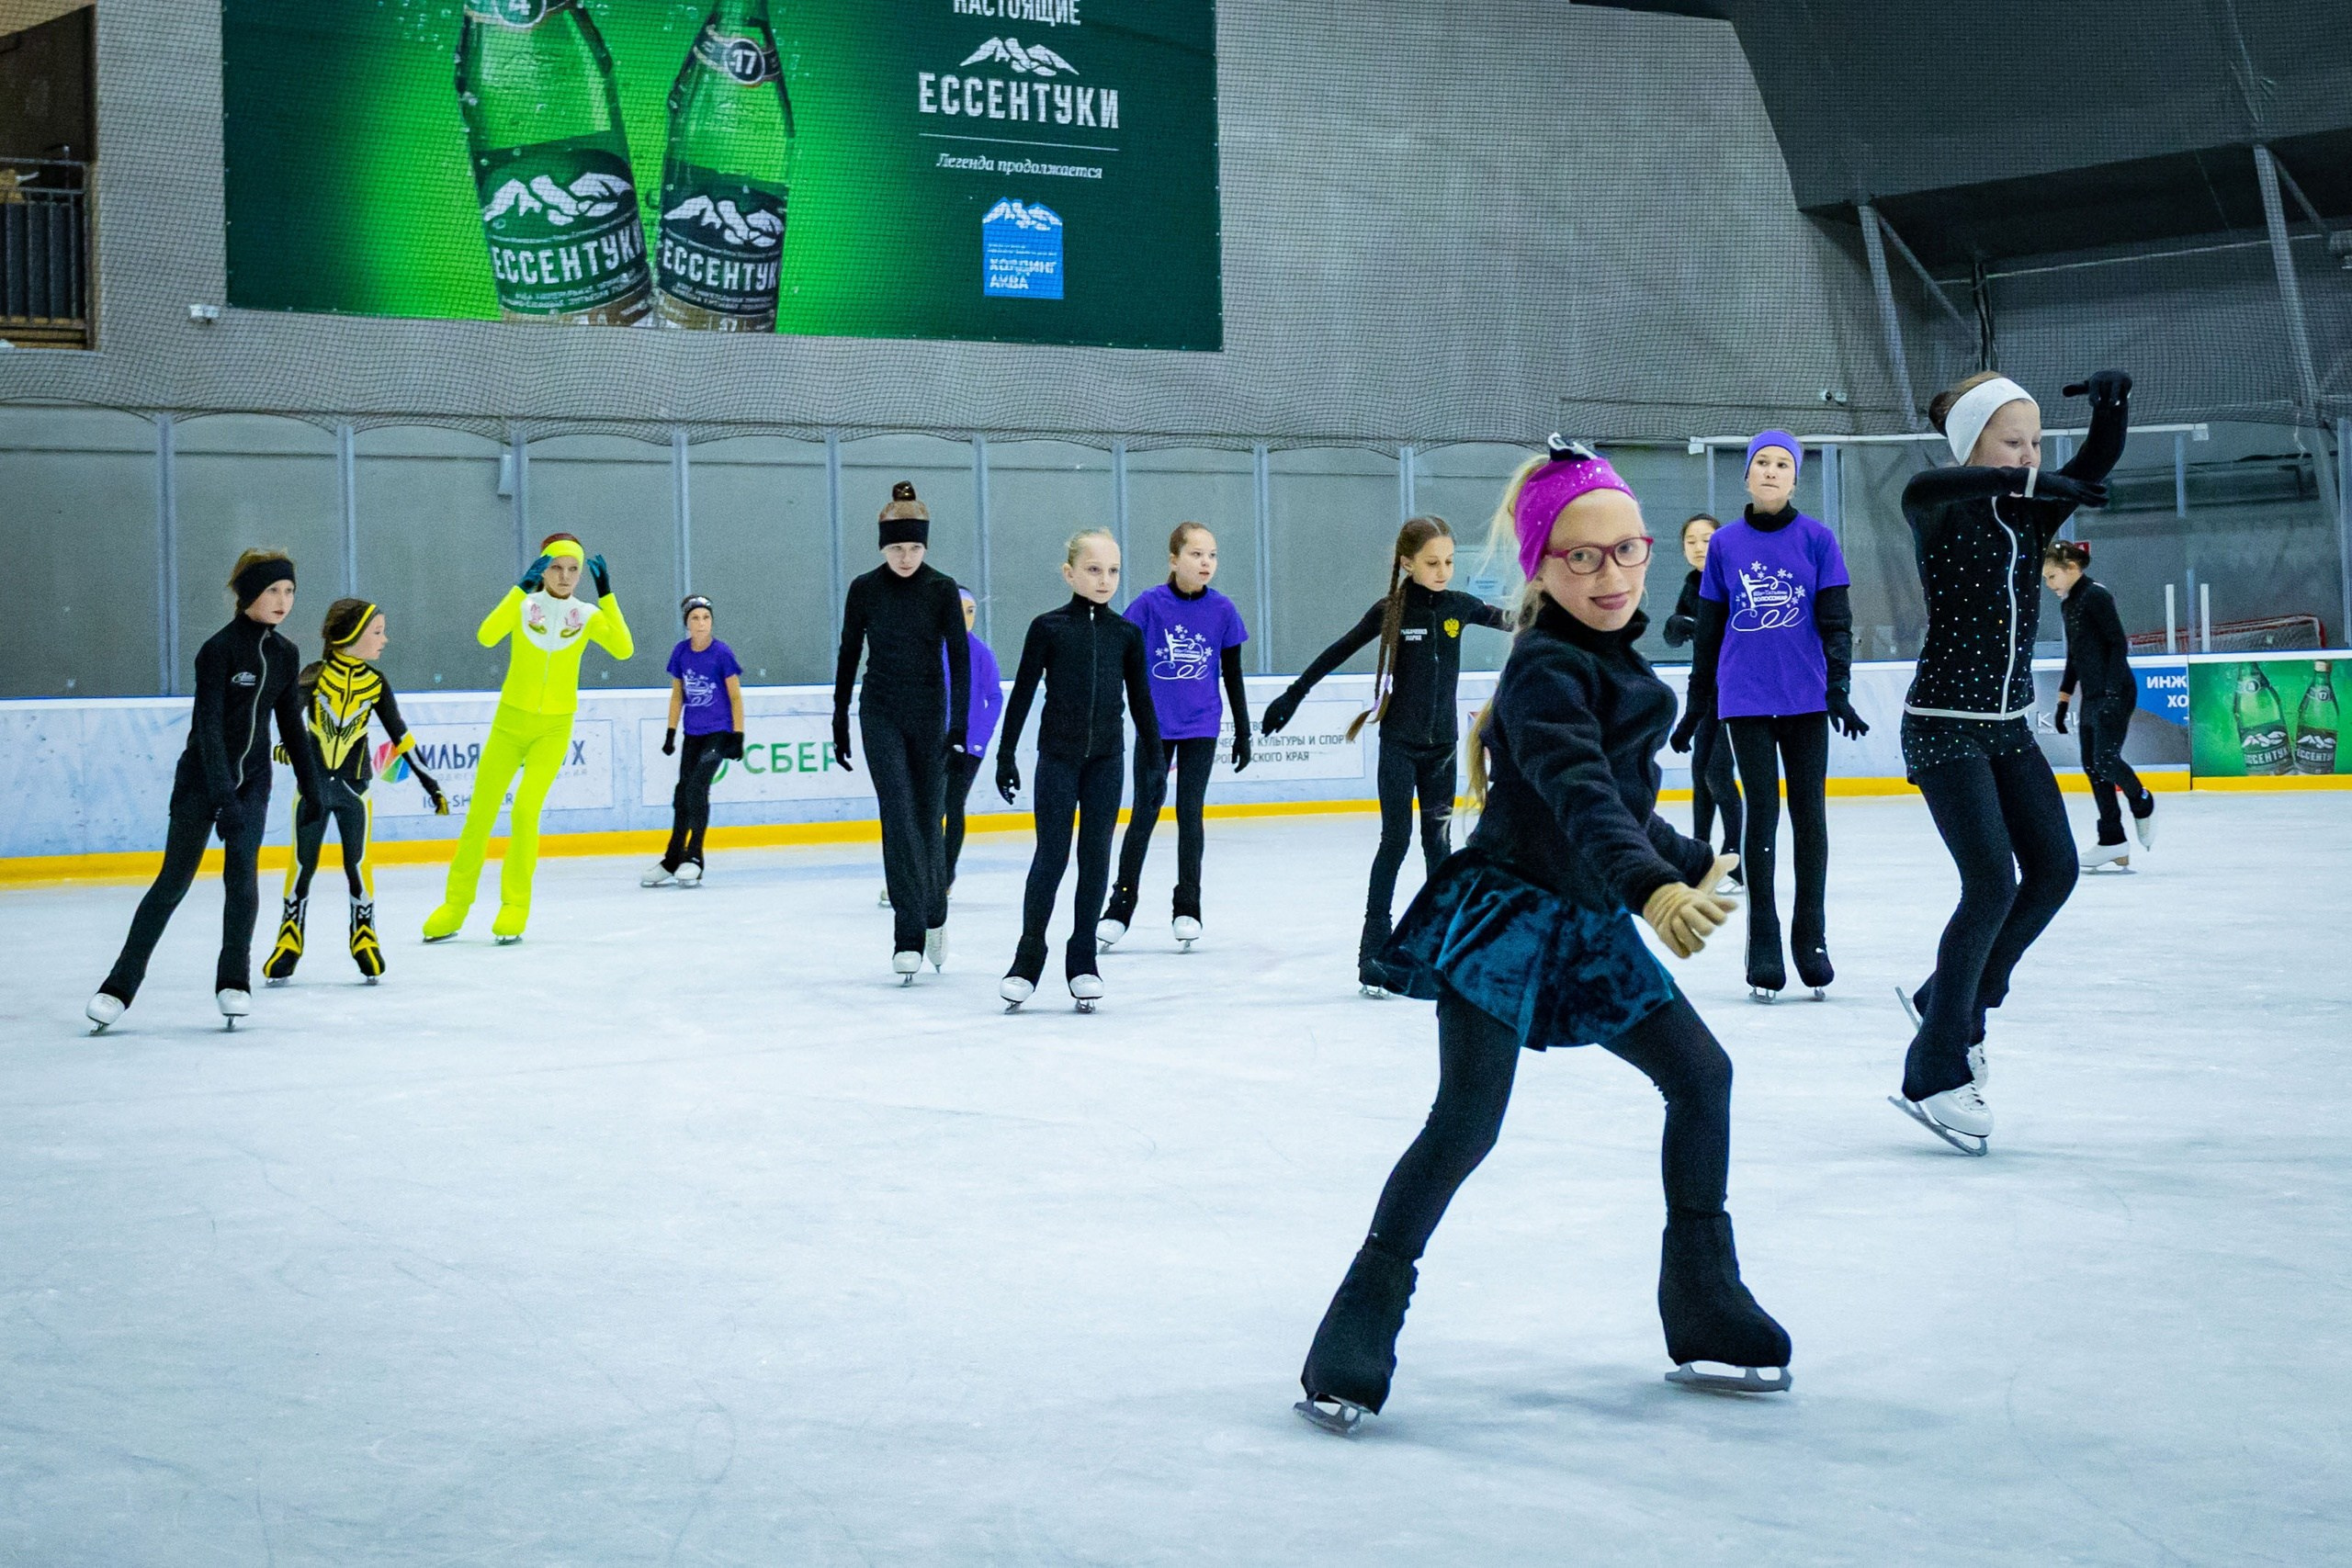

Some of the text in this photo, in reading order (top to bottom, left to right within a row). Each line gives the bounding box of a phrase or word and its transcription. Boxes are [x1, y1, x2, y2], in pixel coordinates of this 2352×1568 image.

[919, 72, 1119, 129] ЕССЕНТУКИ
[935, 153, 1102, 179] Легенда продолжается
[1258, 736, 1306, 747] КУЛЬТУРЫ
[1308, 736, 1316, 745] И
[422, 742, 480, 770] ИЛЬЯ
[1286, 751, 1309, 761] КРАЯ
